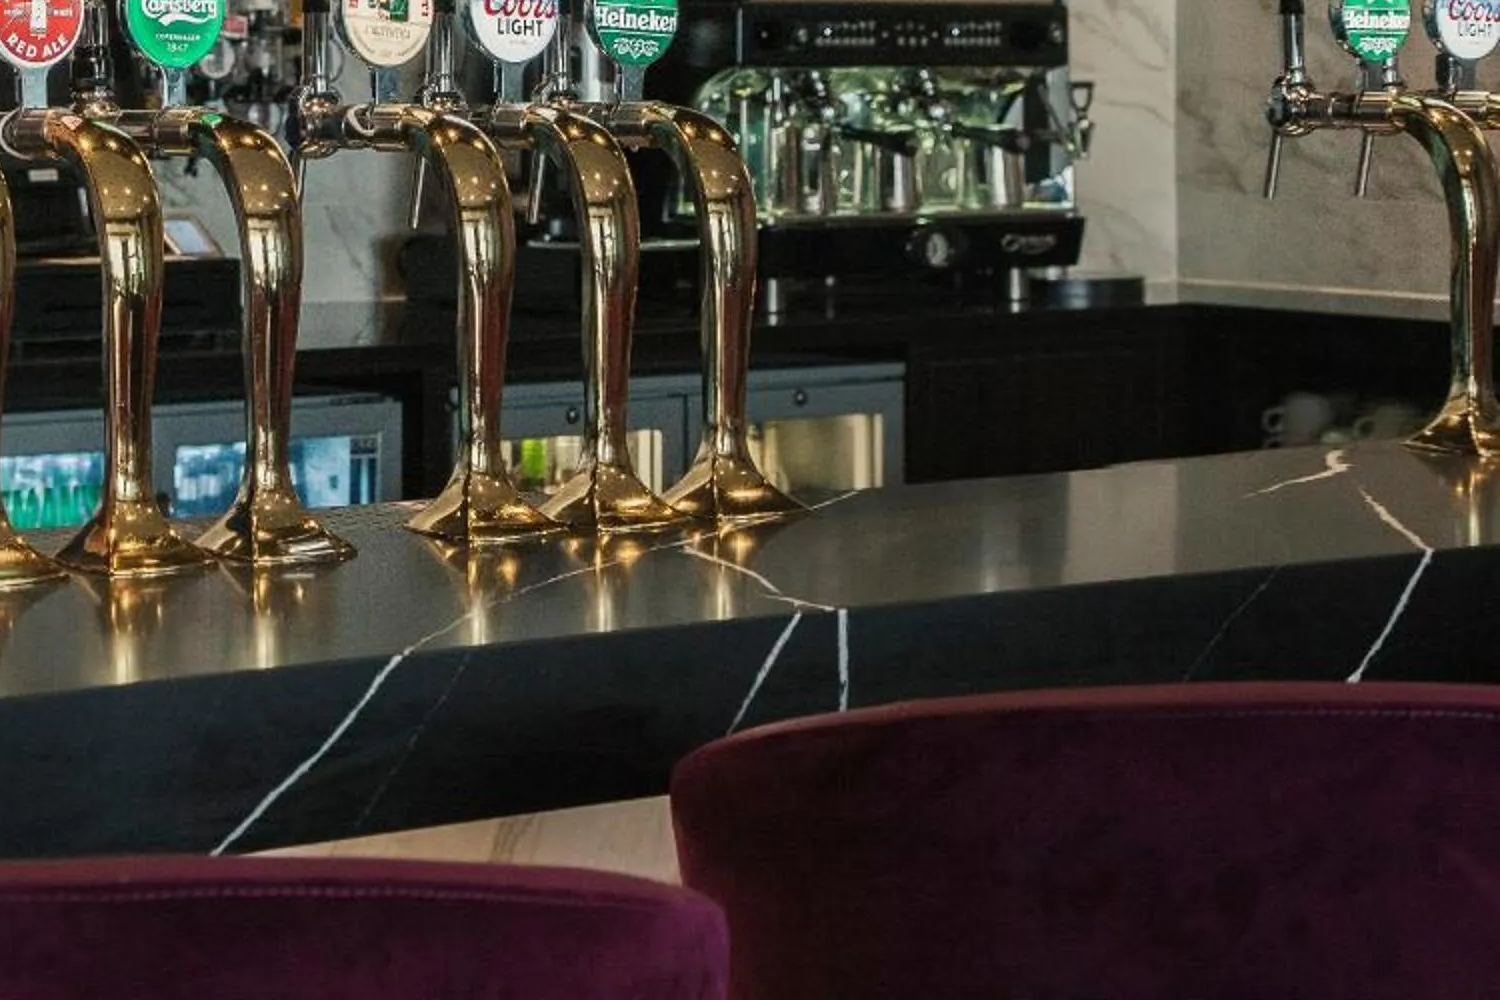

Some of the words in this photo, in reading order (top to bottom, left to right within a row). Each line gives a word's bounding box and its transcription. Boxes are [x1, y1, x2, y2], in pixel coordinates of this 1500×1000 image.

[497, 17, 544, 37] LIGHT
[595, 5, 678, 33] Heineken
[6, 32, 37, 58] RED
[42, 33, 69, 58] ALE
